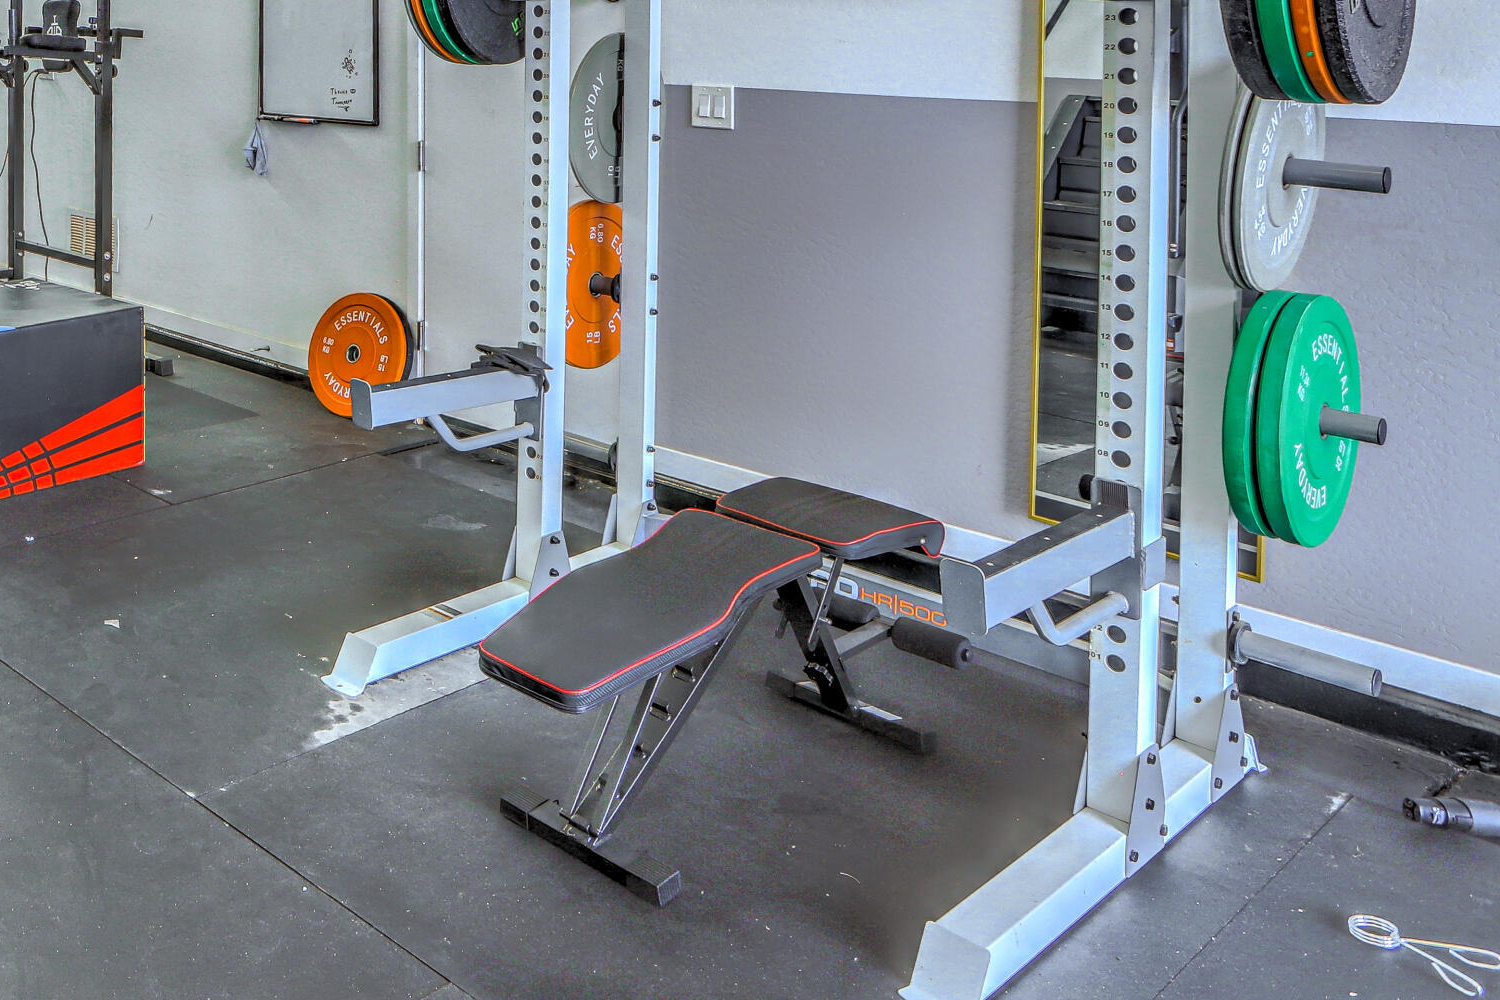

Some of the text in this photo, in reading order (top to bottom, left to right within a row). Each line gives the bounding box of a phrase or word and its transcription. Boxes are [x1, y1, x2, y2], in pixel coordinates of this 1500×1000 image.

[585, 72, 604, 160] EVERYDAY
[1271, 187, 1308, 256] VERYDAY
[589, 226, 597, 240] KG
[334, 310, 388, 345] ESSENTIALS
[586, 332, 593, 343] 15
[593, 330, 601, 344] LB
[324, 372, 351, 399] RYDAY
[1100, 391, 1109, 399] 10
[1098, 420, 1109, 428] 09
[1097, 449, 1108, 457] 08
[1294, 443, 1327, 509] EVERYDAY
[1090, 651, 1101, 660] 01
